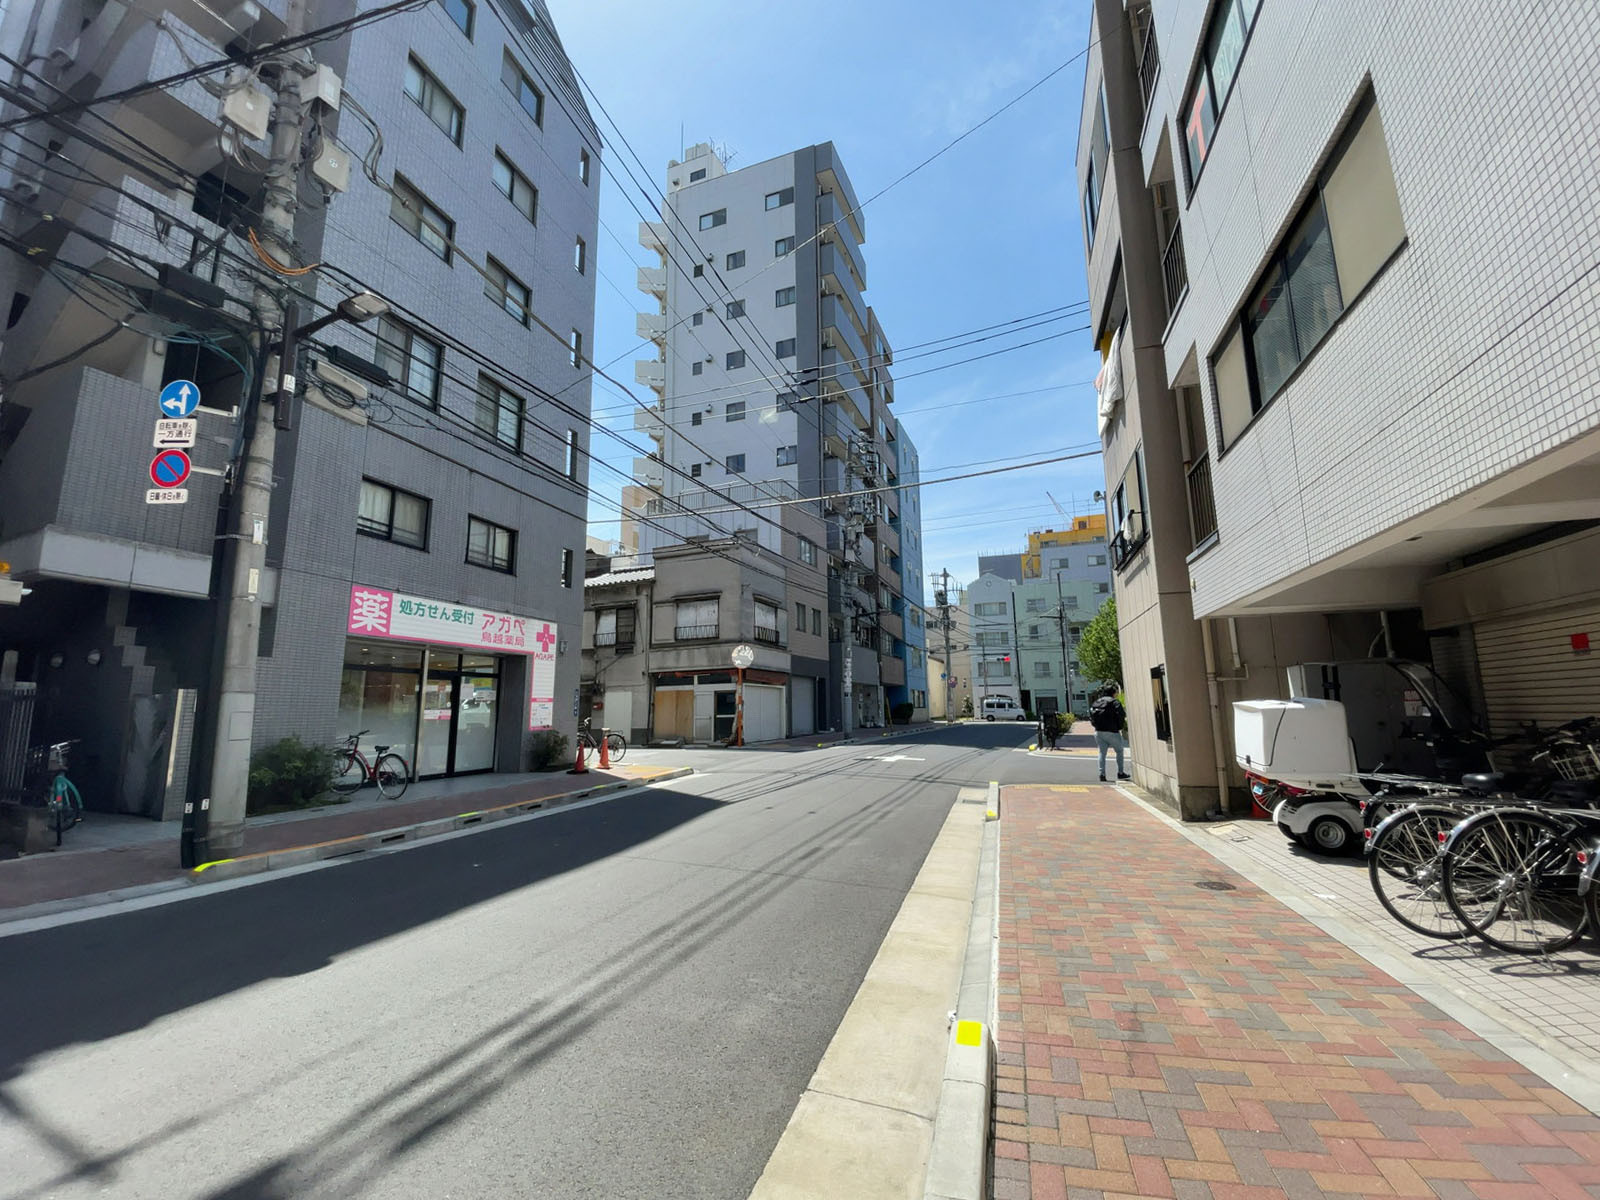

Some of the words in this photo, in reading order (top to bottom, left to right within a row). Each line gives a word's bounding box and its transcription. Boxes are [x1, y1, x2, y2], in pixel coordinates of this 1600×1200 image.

[158, 430, 192, 438] 一方通行
[159, 422, 192, 430] 自転車を除く
[351, 591, 389, 632] 薬
[399, 599, 475, 625] 処方せん受付
[481, 613, 526, 635] アガペ
[480, 631, 525, 648] 鳥越薬局
[535, 652, 555, 661] AGAPE
